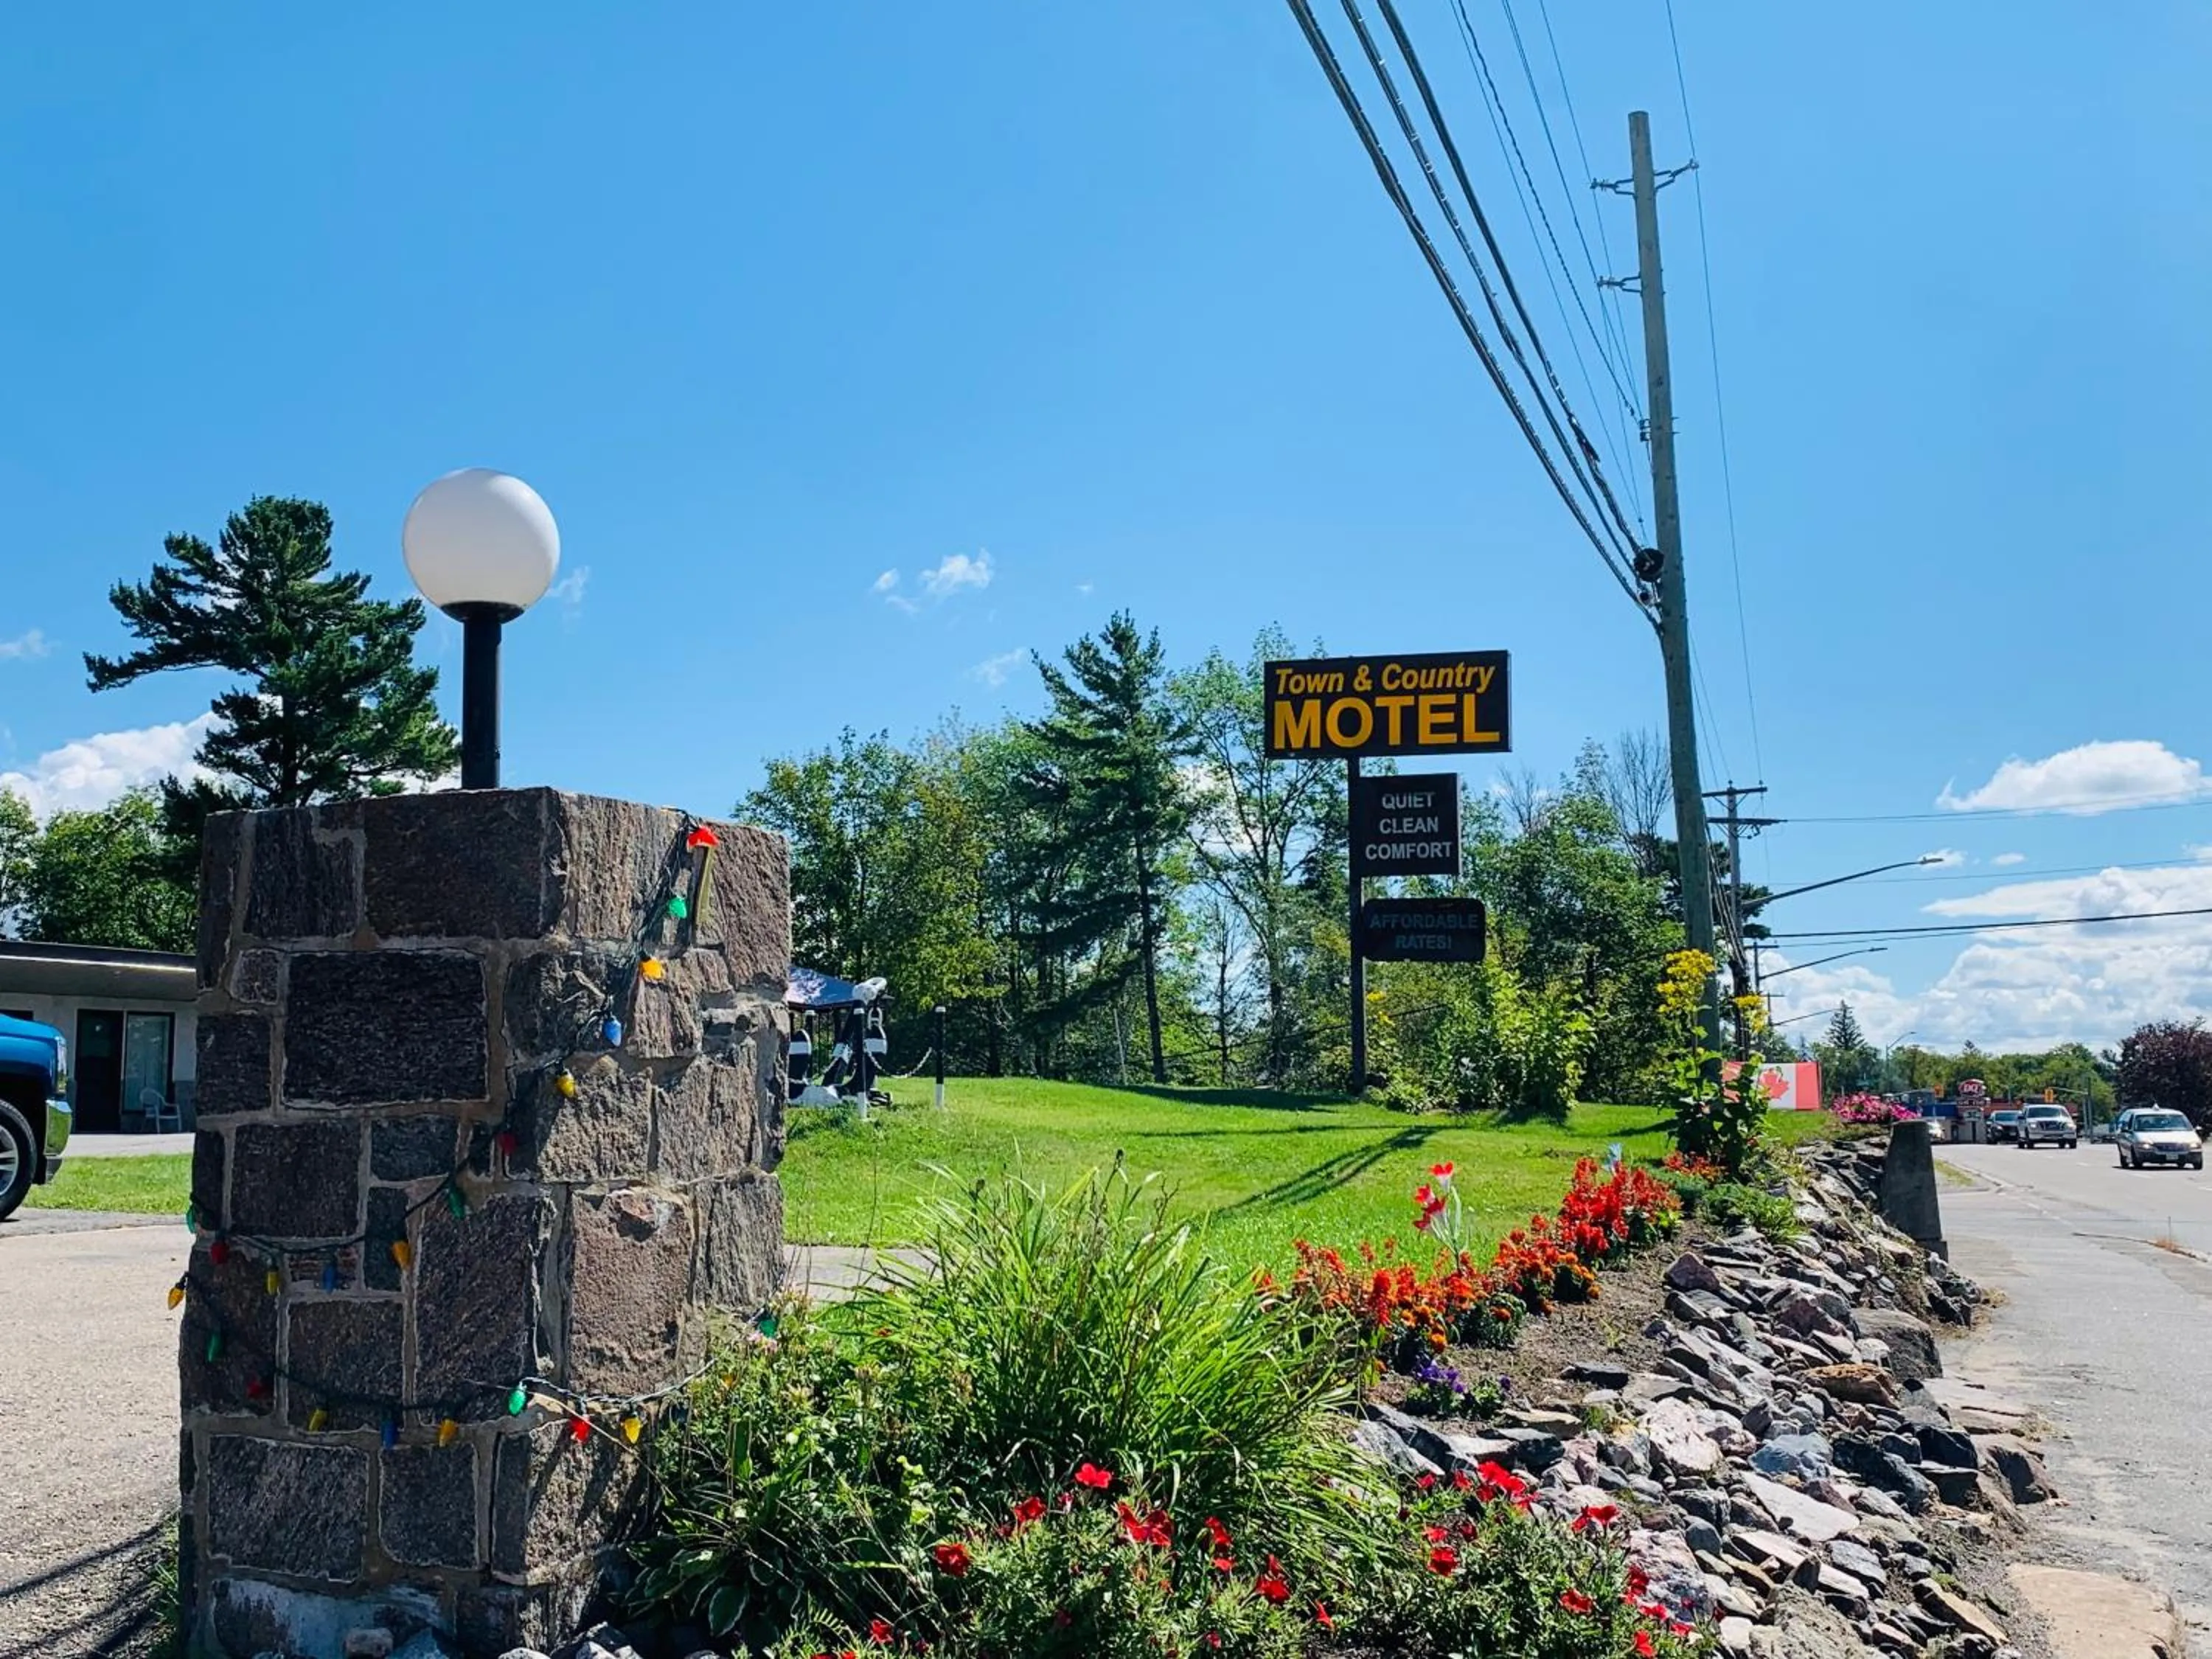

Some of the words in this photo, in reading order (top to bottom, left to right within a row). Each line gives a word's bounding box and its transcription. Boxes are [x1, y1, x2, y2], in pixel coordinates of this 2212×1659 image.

[1274, 667, 1345, 695] Town
[1352, 664, 1374, 693] &
[1381, 661, 1496, 695] Country
[1273, 693, 1500, 750] MOTEL
[1381, 791, 1436, 810] QUIET
[1379, 816, 1439, 835] CLEAN
[1365, 841, 1453, 860] COMFORT
[1368, 914, 1479, 929] AFFORDABLE
[1395, 934, 1452, 950] RATES!
